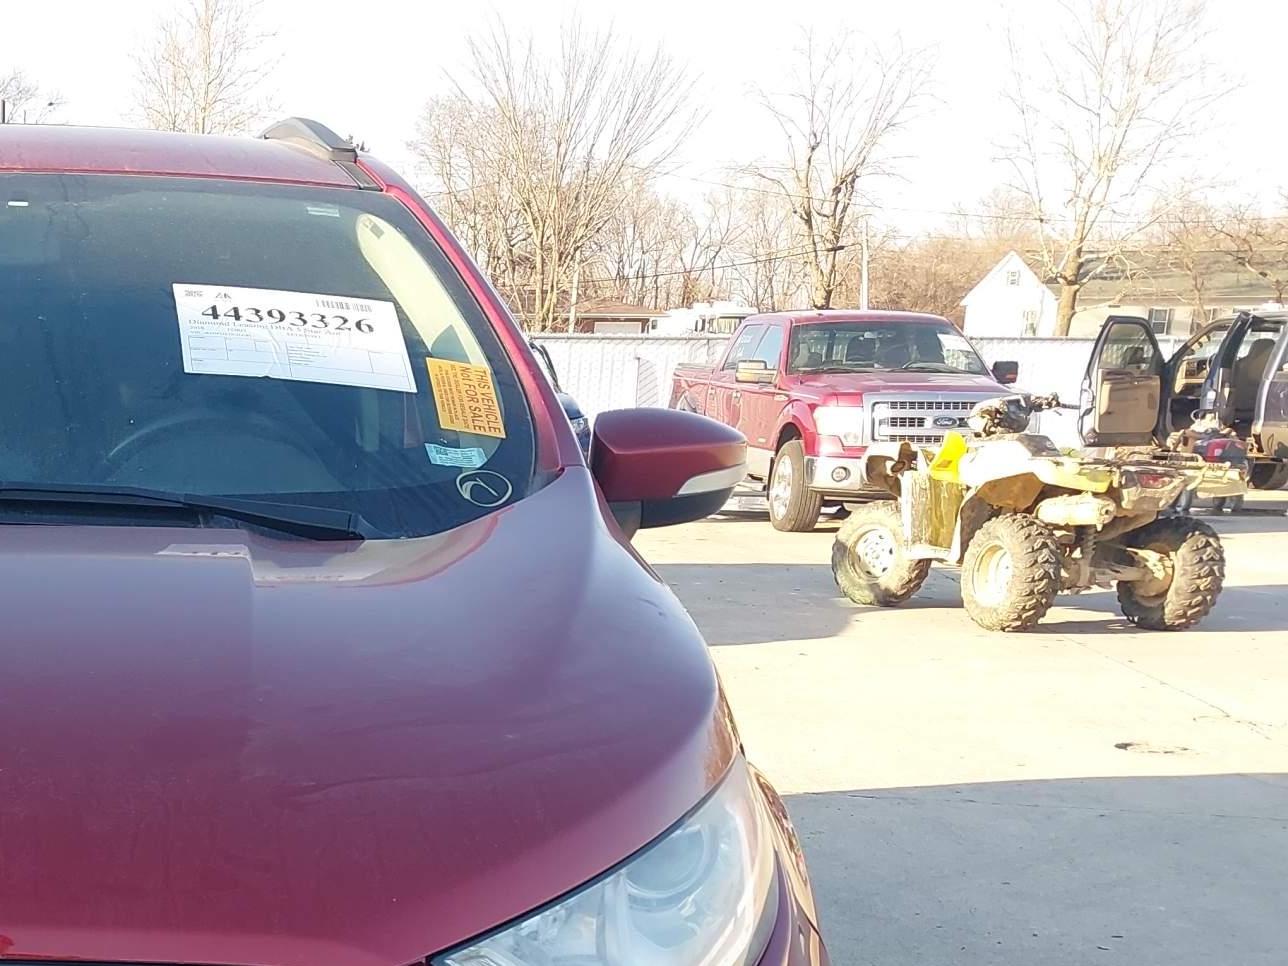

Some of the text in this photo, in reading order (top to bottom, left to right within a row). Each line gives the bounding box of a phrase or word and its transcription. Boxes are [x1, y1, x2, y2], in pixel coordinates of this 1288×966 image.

[201, 304, 374, 334] 44393326
[465, 383, 479, 404] FOR
[474, 369, 501, 434] THIS VEHICLE
[468, 405, 487, 432] SALE
